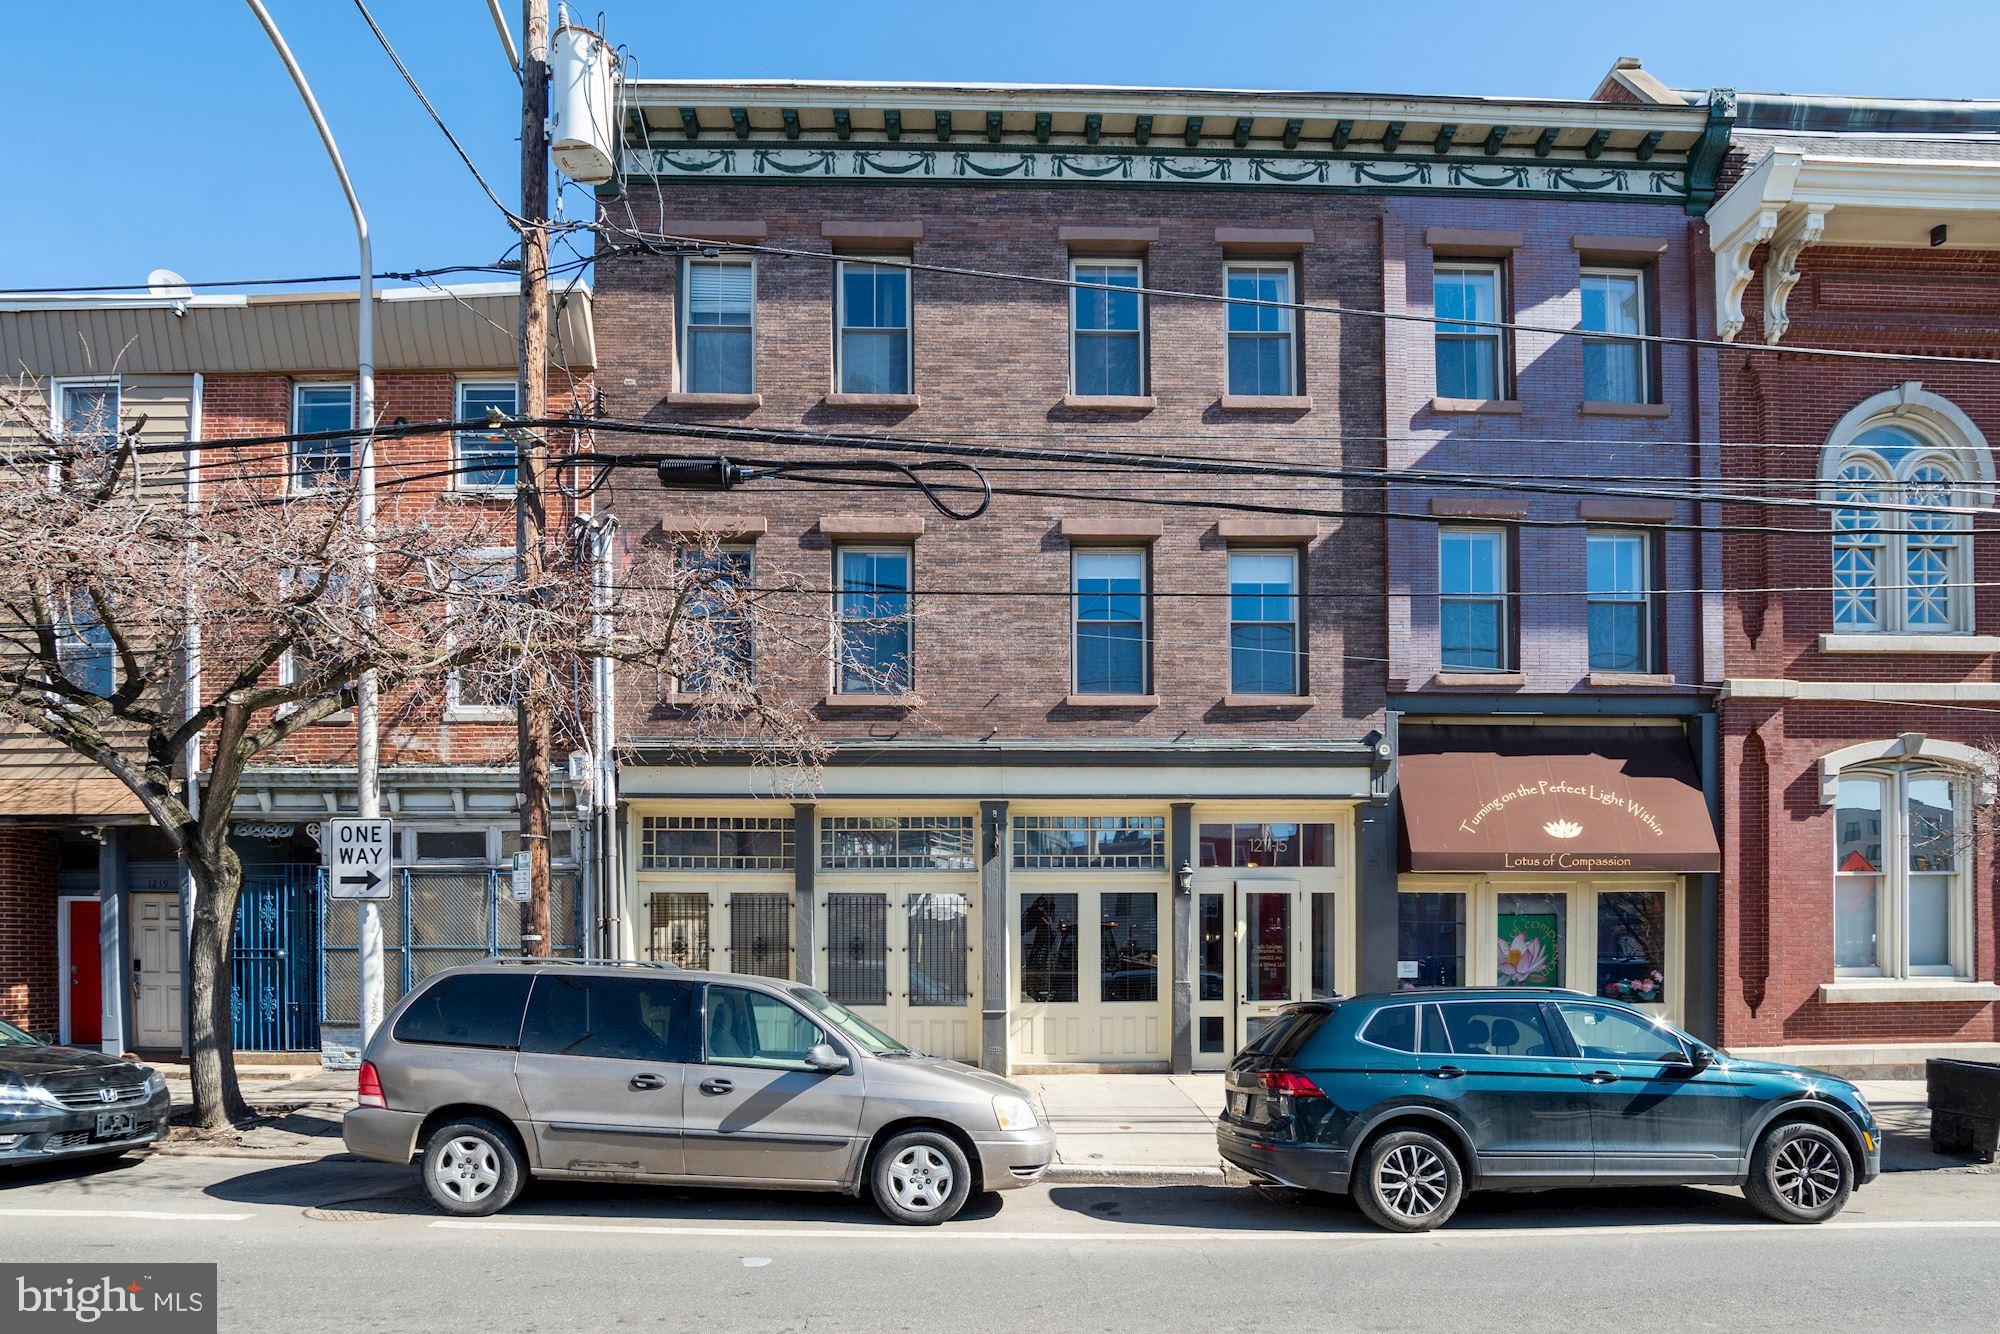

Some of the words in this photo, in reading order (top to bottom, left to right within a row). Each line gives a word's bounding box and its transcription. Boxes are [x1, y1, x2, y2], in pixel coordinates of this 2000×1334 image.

[1459, 798, 1504, 834] Turning
[1501, 792, 1517, 802] on
[1517, 783, 1539, 797] the
[1538, 780, 1587, 796] Perfect
[1590, 785, 1625, 807] Light
[1627, 799, 1663, 836] Within
[340, 825, 383, 843] ONE
[339, 847, 383, 865] WAY
[1505, 853, 1540, 868] Lotus
[1542, 853, 1556, 867] of
[1558, 853, 1631, 871] Compassion
[148, 879, 169, 889] 1219
